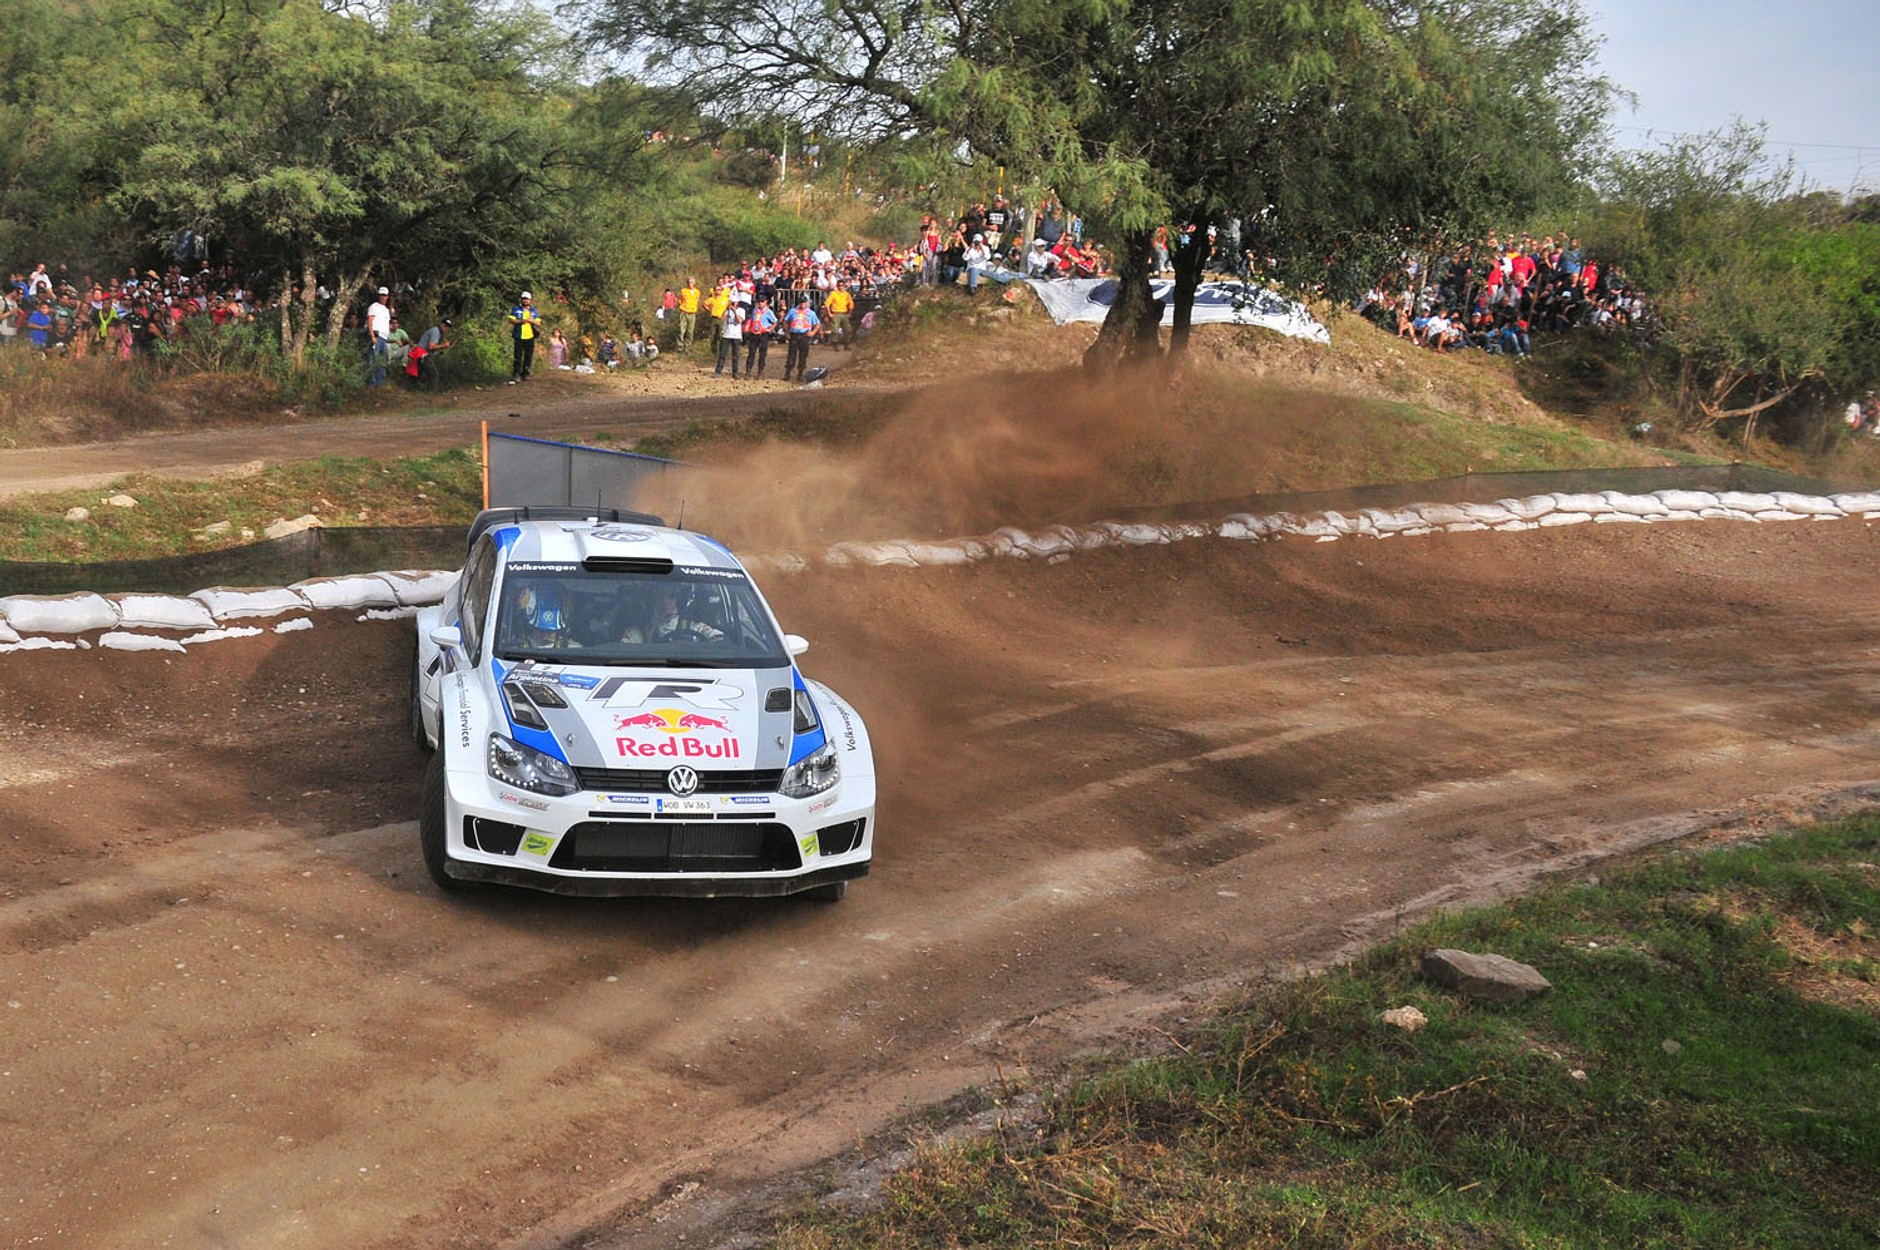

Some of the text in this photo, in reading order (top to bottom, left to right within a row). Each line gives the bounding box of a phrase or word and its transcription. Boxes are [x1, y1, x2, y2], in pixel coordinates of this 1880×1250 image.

[508, 564, 577, 572] Volkswagen
[680, 567, 745, 579] Volkswagen
[460, 709, 472, 748] Services
[615, 736, 740, 758] Red Bull
